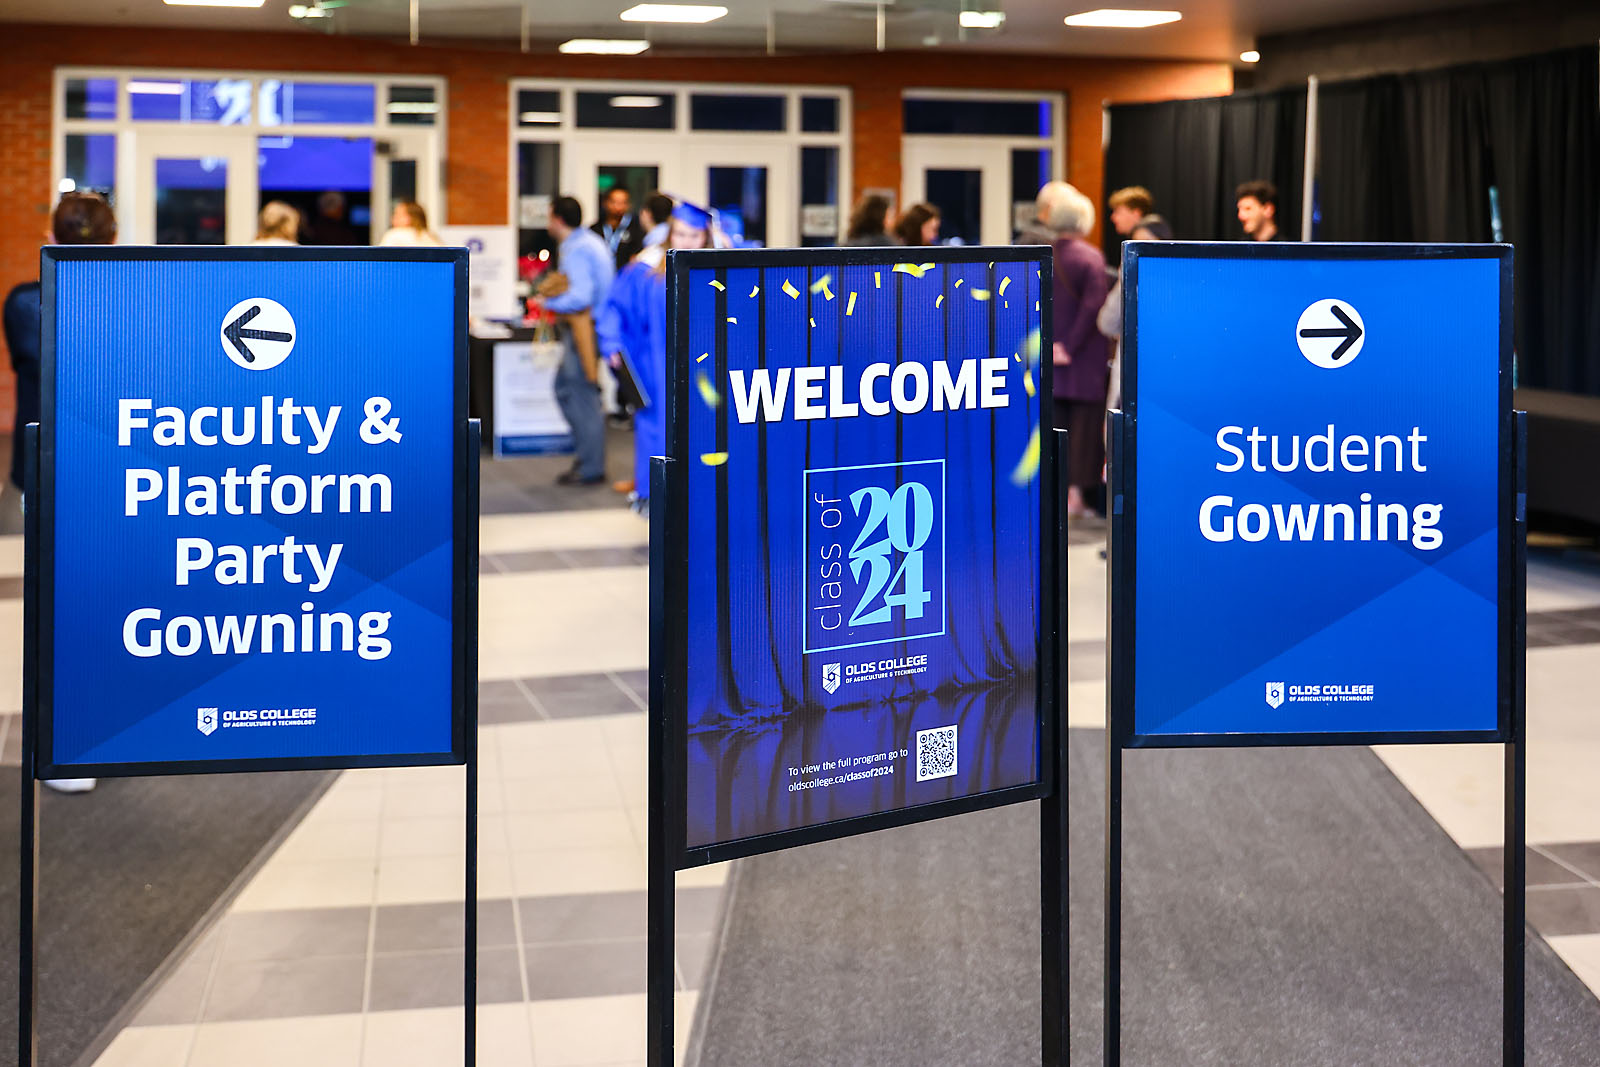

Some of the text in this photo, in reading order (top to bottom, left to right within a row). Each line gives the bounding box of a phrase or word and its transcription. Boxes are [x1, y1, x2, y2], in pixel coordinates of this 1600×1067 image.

[729, 357, 1010, 424] WELCOME
[118, 395, 403, 455] Faculty &
[1215, 423, 1428, 473] Student
[124, 463, 392, 517] Platform
[849, 482, 934, 559] 20
[1198, 492, 1444, 551] Gowning
[175, 535, 344, 593] Party
[814, 492, 842, 630] class of
[848, 550, 931, 627] 24
[122, 601, 392, 661] Gowning
[845, 655, 927, 676] OLDS COLLEGE
[853, 672, 888, 683] AGRICULTURE
[894, 666, 928, 677] TECHNOLOGY
[1288, 684, 1374, 696] OLDS COLLEGE
[222, 708, 317, 721] OLDS COLLEGE
[231, 720, 271, 728] AGRICULTURE
[788, 748, 908, 777] To view the full program go to
[788, 765, 894, 792] oldscollege.ca/classof2024
